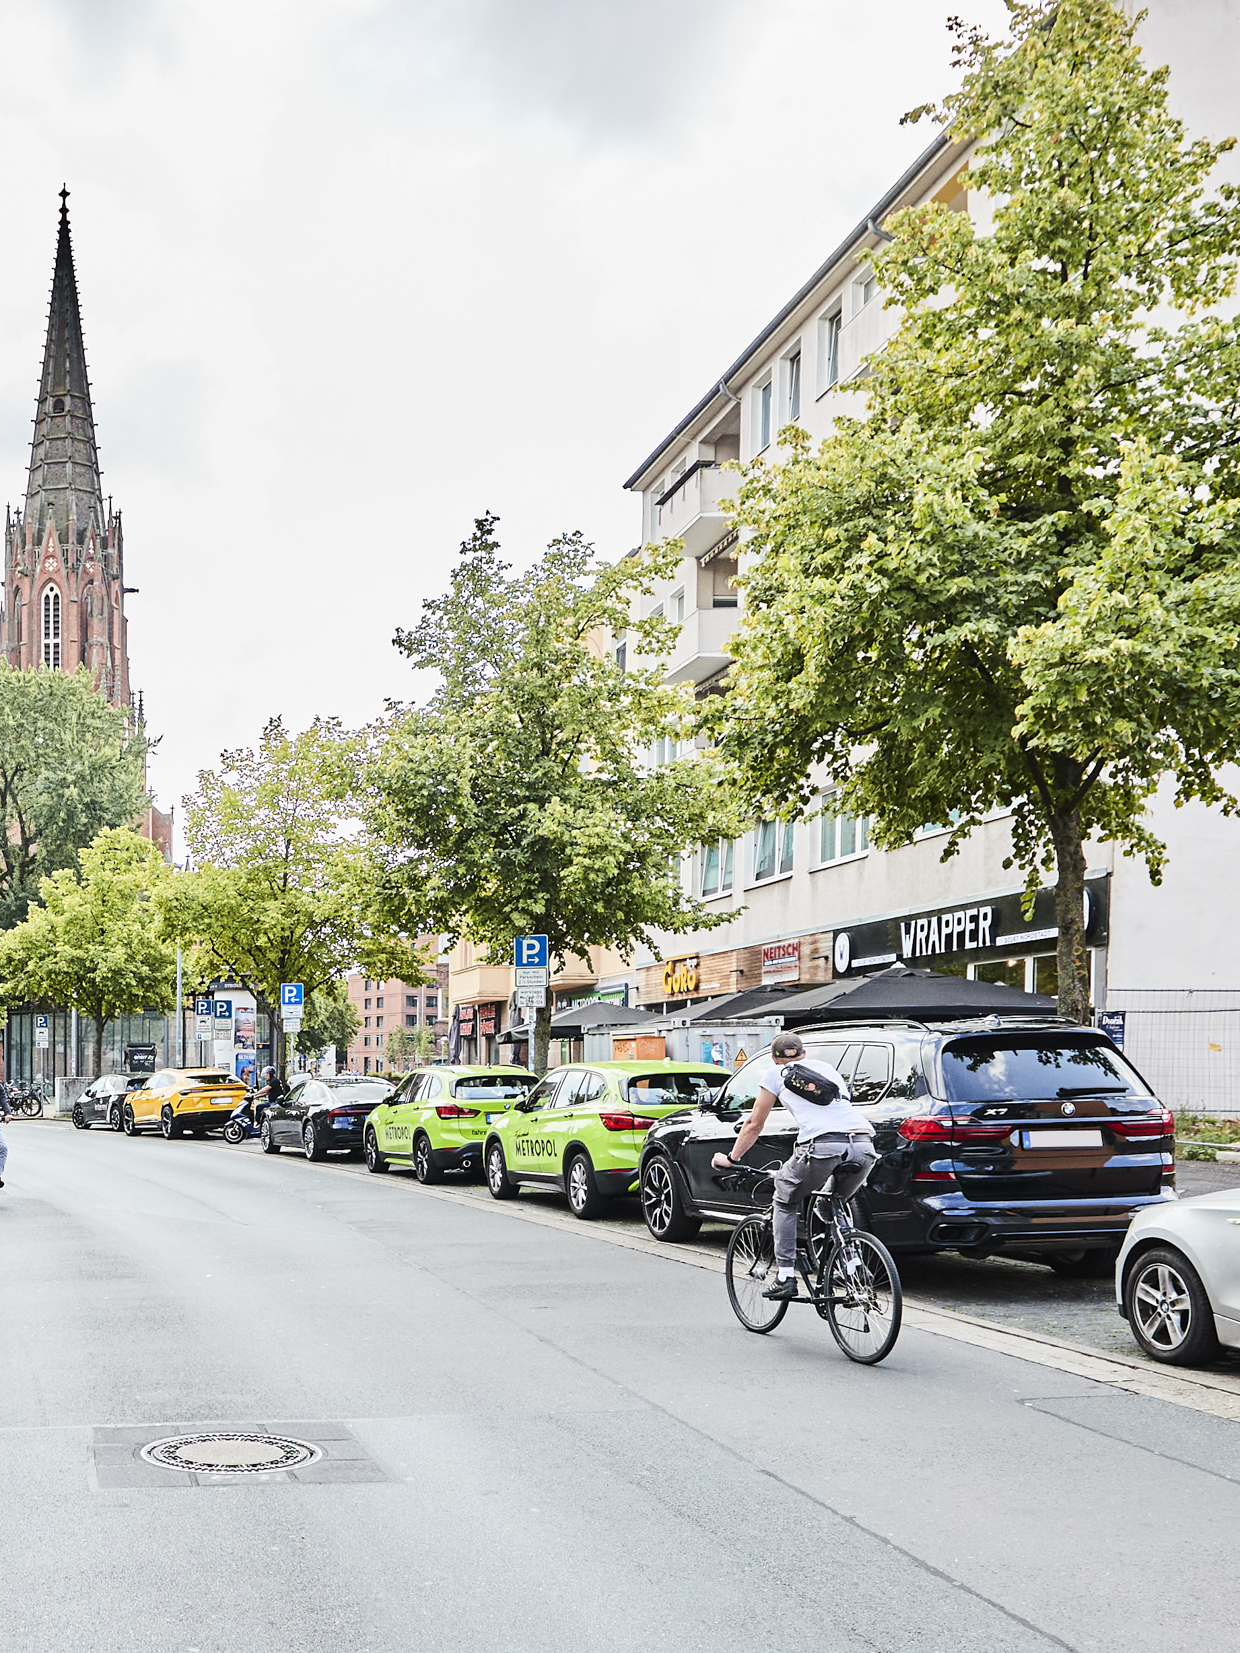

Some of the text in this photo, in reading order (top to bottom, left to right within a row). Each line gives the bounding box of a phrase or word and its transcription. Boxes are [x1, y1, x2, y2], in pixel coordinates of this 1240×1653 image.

[900, 906, 992, 959] WRAPPER
[522, 939, 540, 964] P
[763, 942, 798, 966] NEITSCH
[285, 986, 297, 1003] P
[198, 1001, 207, 1014] P
[216, 1002, 227, 1017] P
[37, 1016, 45, 1026] P
[983, 1108, 1009, 1116] X7
[385, 1126, 412, 1140] METROPOL
[515, 1139, 558, 1157] METROPOL
